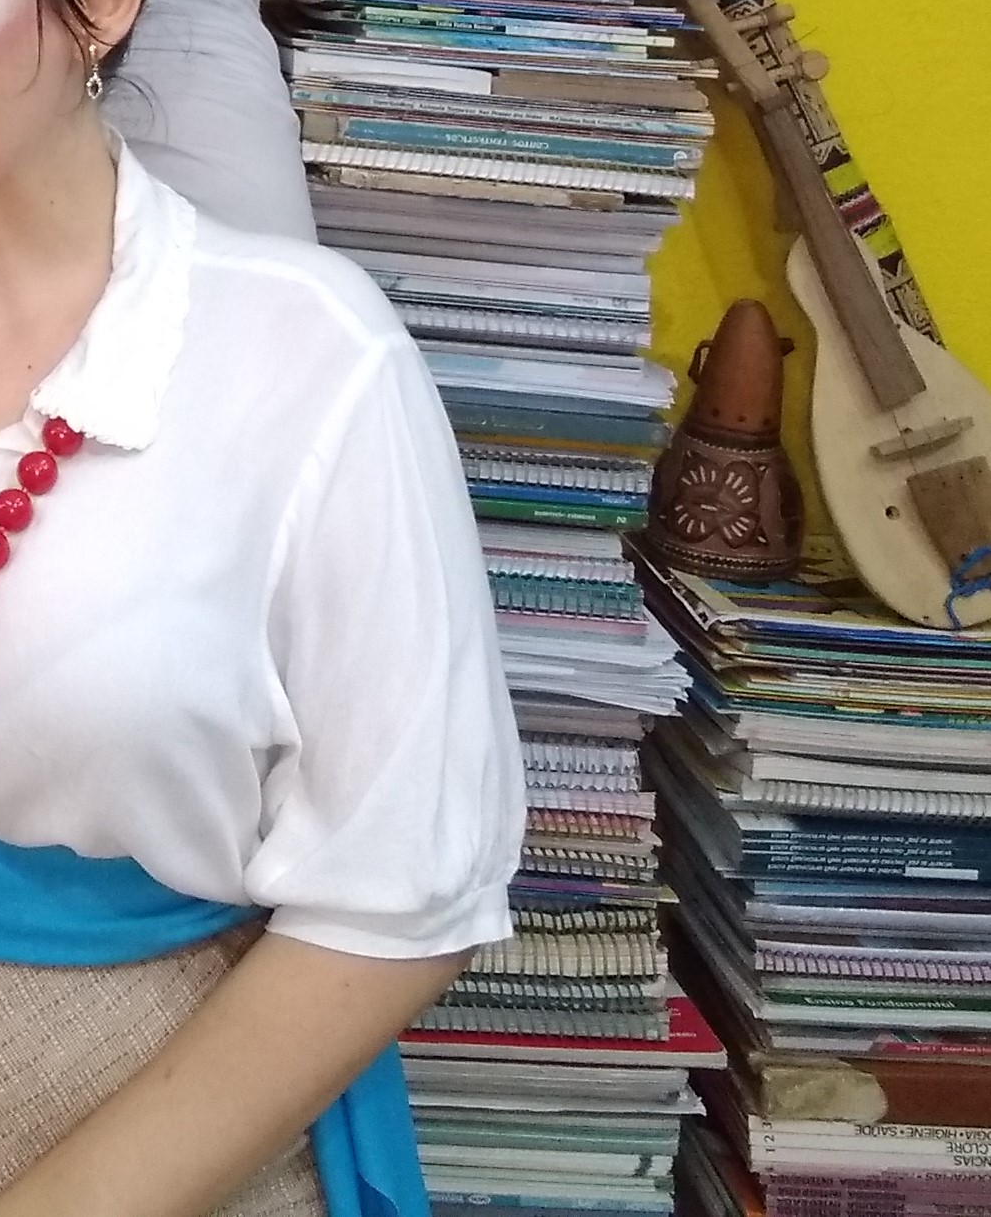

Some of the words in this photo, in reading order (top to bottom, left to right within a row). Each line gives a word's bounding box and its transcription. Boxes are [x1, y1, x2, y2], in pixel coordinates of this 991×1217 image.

[856, 997, 957, 1010] Fundamental
[855, 1124, 898, 1137] SAÚDE
[906, 1126, 958, 1139] HIGIENE
[945, 1141, 991, 1154] CLORE
